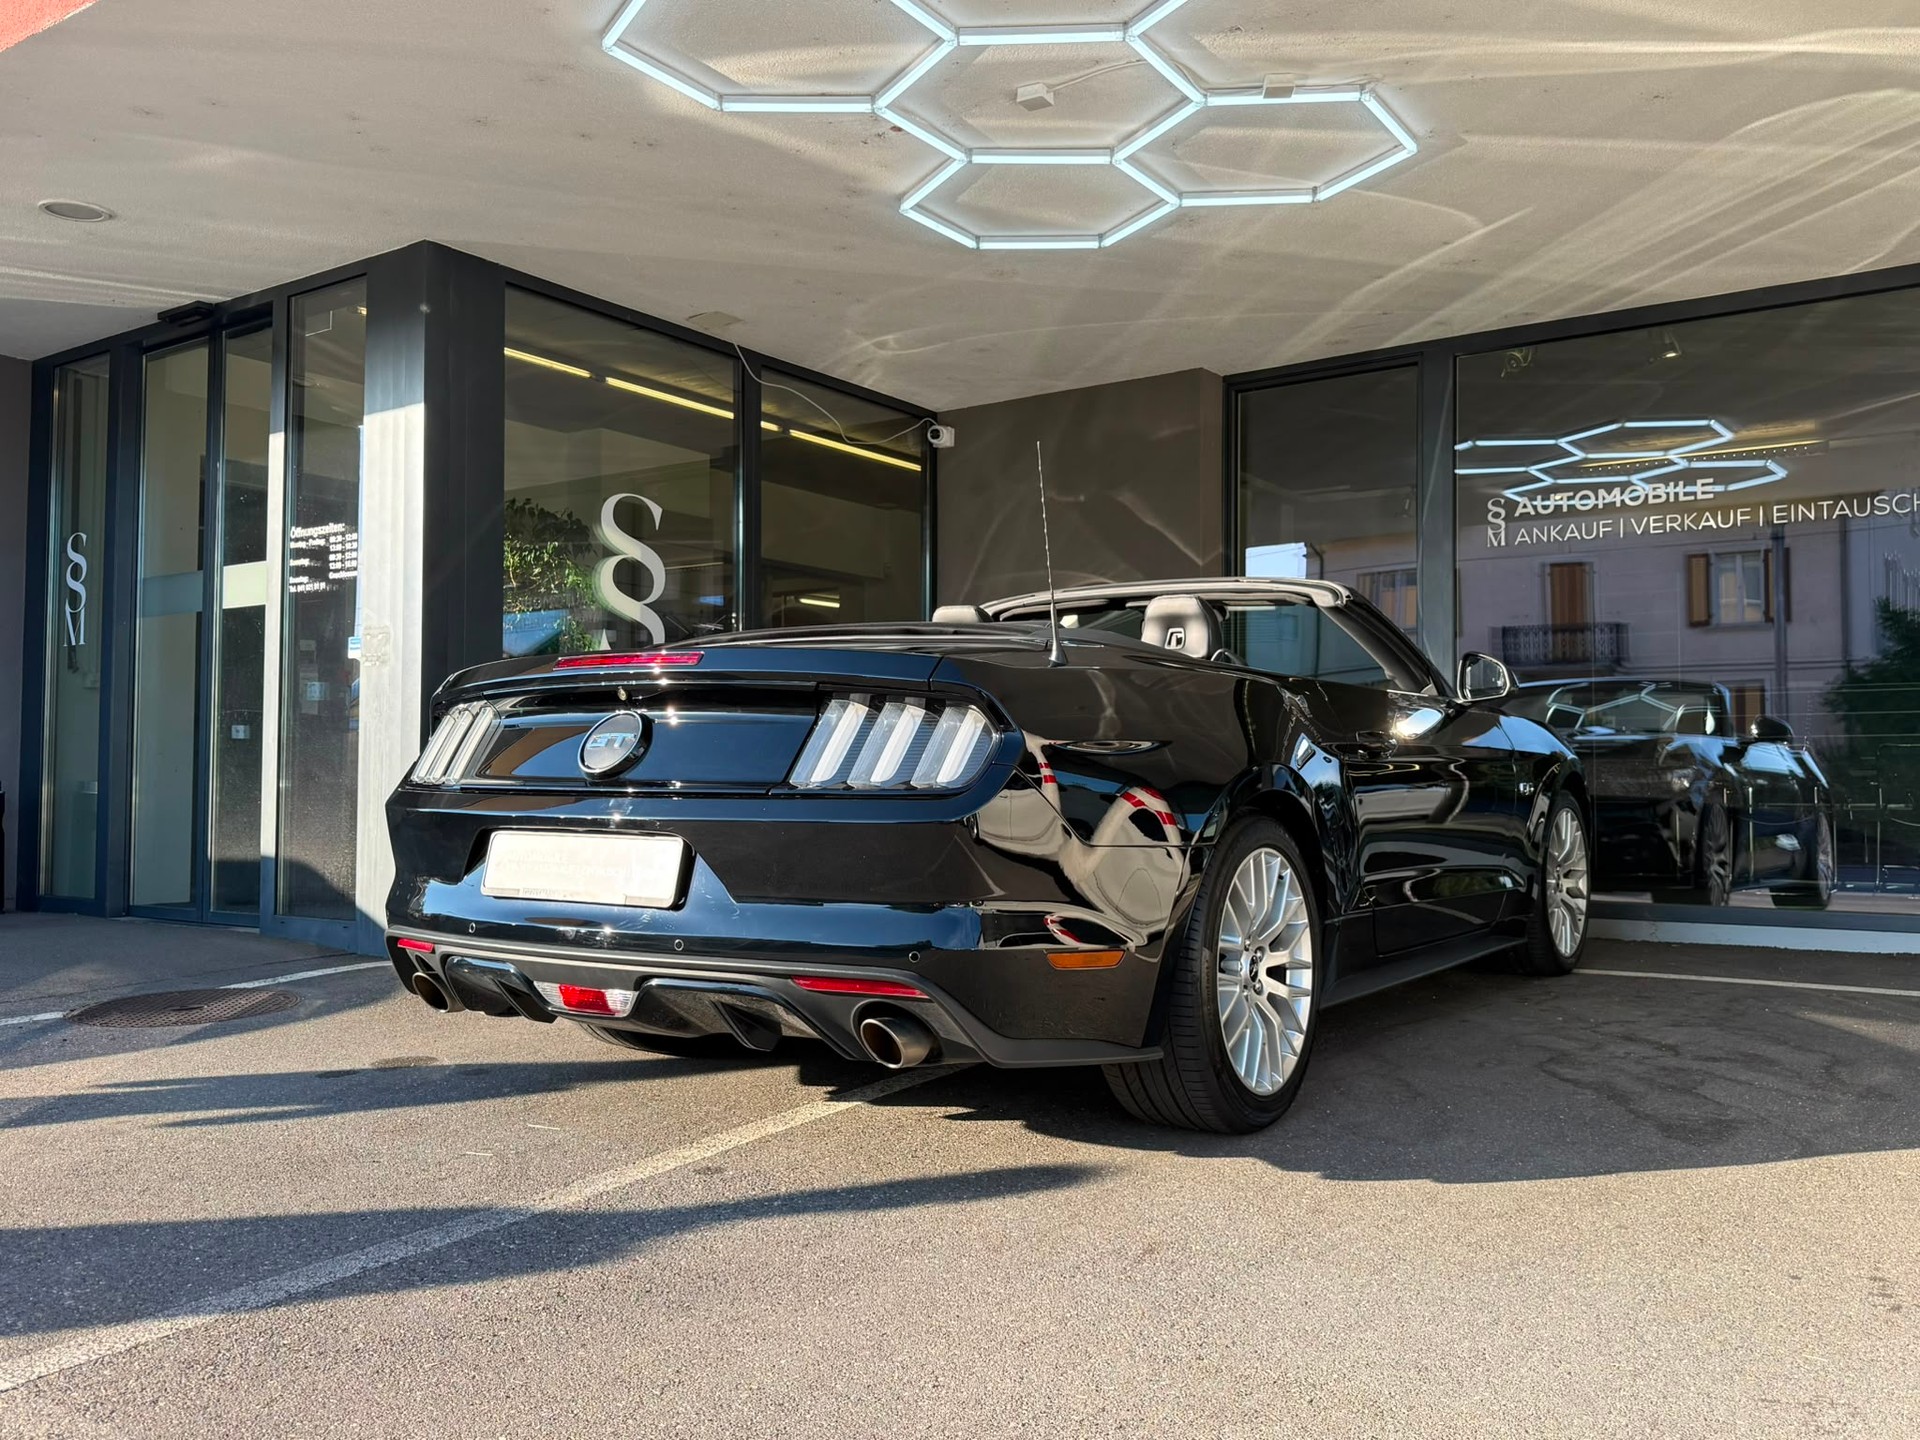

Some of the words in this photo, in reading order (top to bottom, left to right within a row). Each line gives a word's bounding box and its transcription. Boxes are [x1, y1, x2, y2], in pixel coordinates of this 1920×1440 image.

[1514, 477, 1714, 517] AUTOMOBILE
[1514, 520, 1613, 546] ANKAUF
[1631, 507, 1752, 536] VERKAUF
[586, 732, 636, 749] GT
